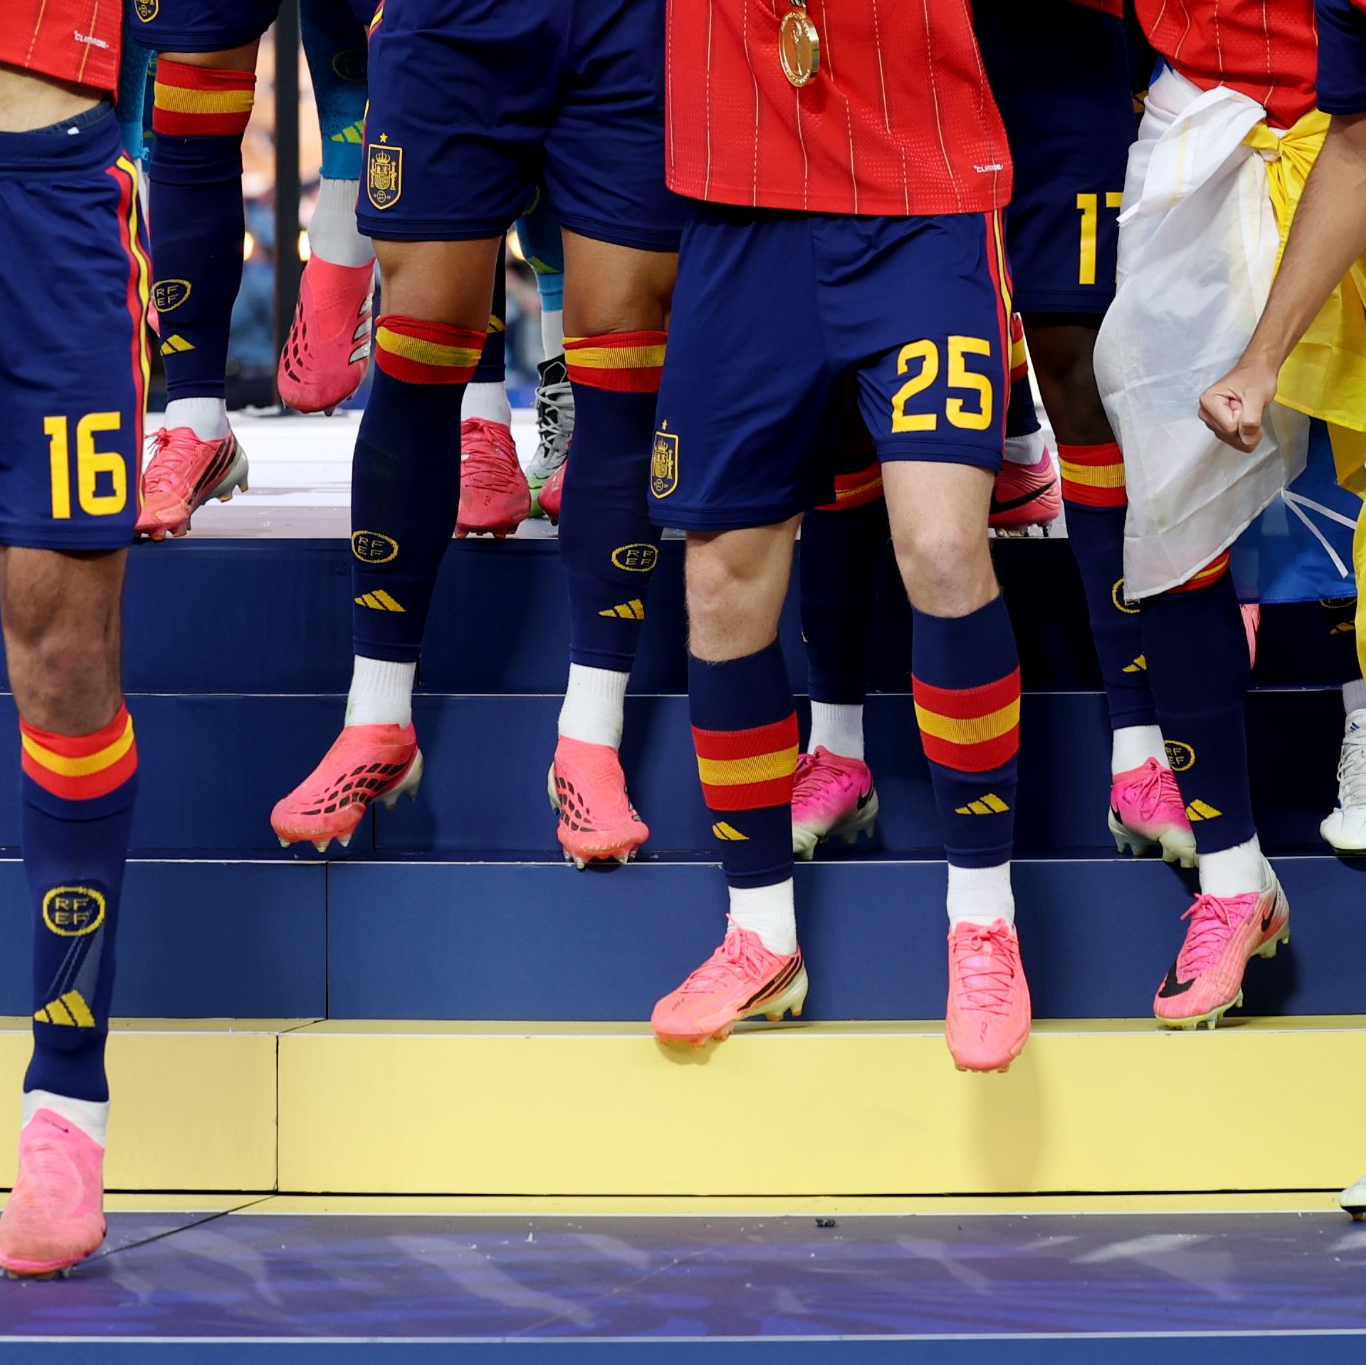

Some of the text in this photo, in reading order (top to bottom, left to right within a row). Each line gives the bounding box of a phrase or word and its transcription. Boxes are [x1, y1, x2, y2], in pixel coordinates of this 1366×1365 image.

[889, 334, 994, 434] 25
[41, 411, 129, 521] 16
[55, 897, 90, 911] RF
[55, 911, 90, 925] EF
